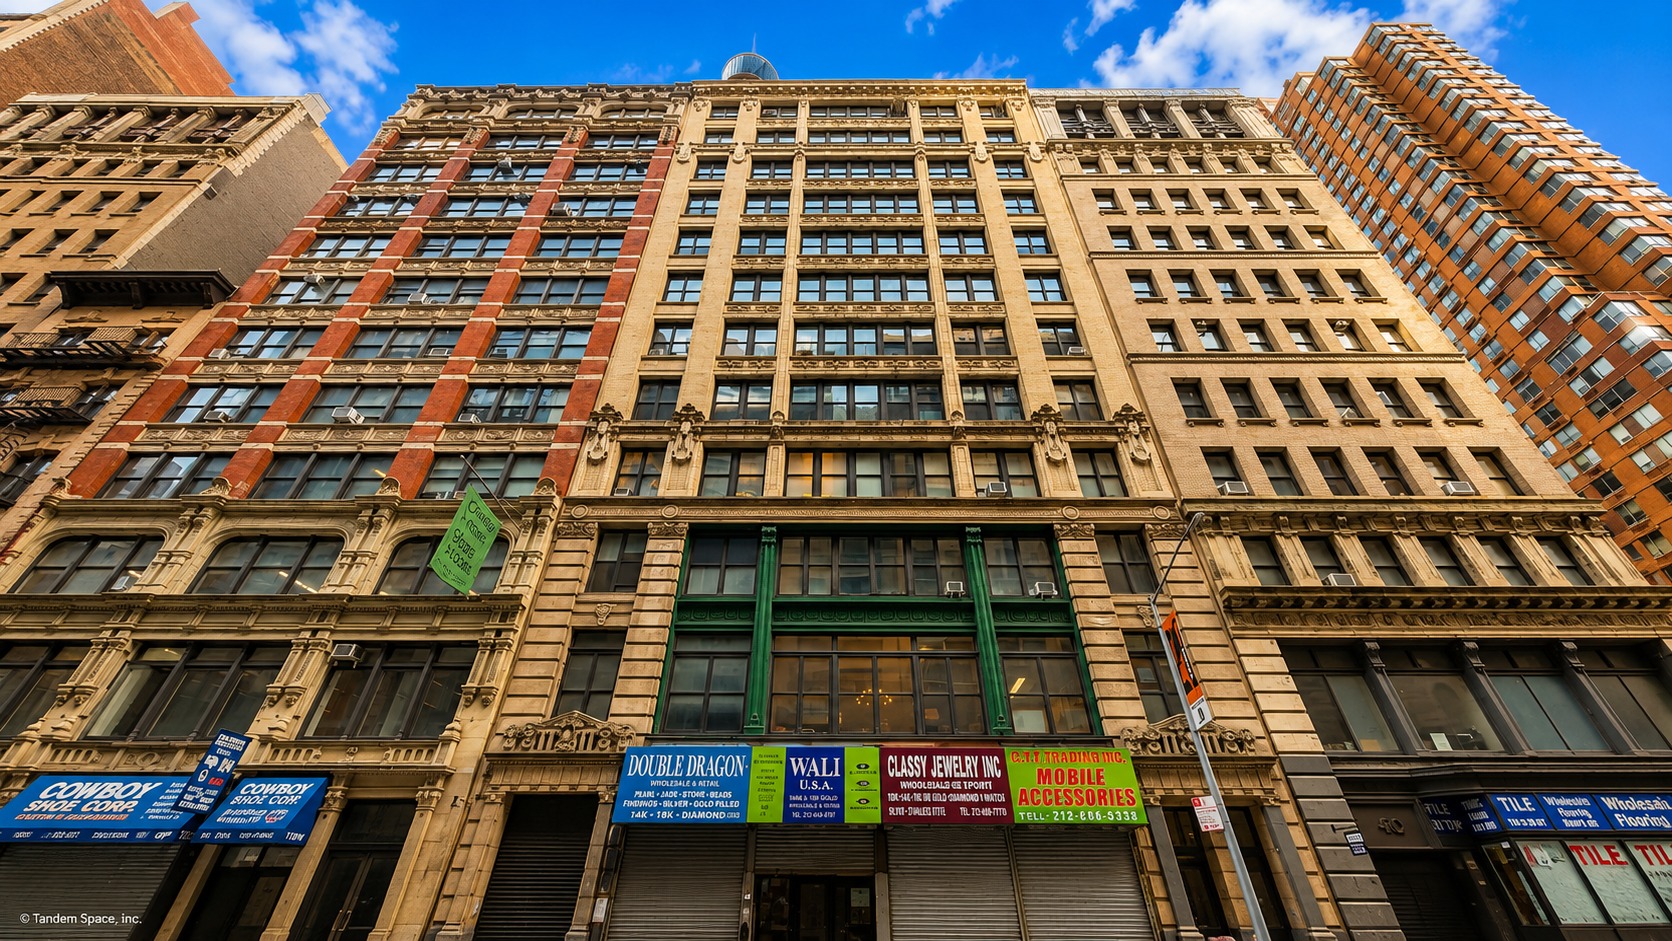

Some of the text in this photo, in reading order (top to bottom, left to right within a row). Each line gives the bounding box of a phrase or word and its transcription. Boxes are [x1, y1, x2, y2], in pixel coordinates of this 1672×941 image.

[627, 755, 684, 777] DOUBLE
[789, 757, 841, 777] WALI
[887, 755, 1001, 778] CLASSY JEWELRY INC
[799, 779, 834, 790] U.S.A.
[1036, 768, 1106, 785] MOBILE
[39, 782, 163, 799] COWBOY
[240, 783, 314, 795] COWBOY
[1018, 788, 1136, 806] ACCESSORIES
[23, 800, 81, 812] SHOE
[81, 800, 139, 812] CORP.
[1496, 797, 1536, 812] TILE
[681, 811, 726, 819] DIAMOND
[1568, 845, 1629, 866] TILE
[1634, 844, 1672, 866] TIL
